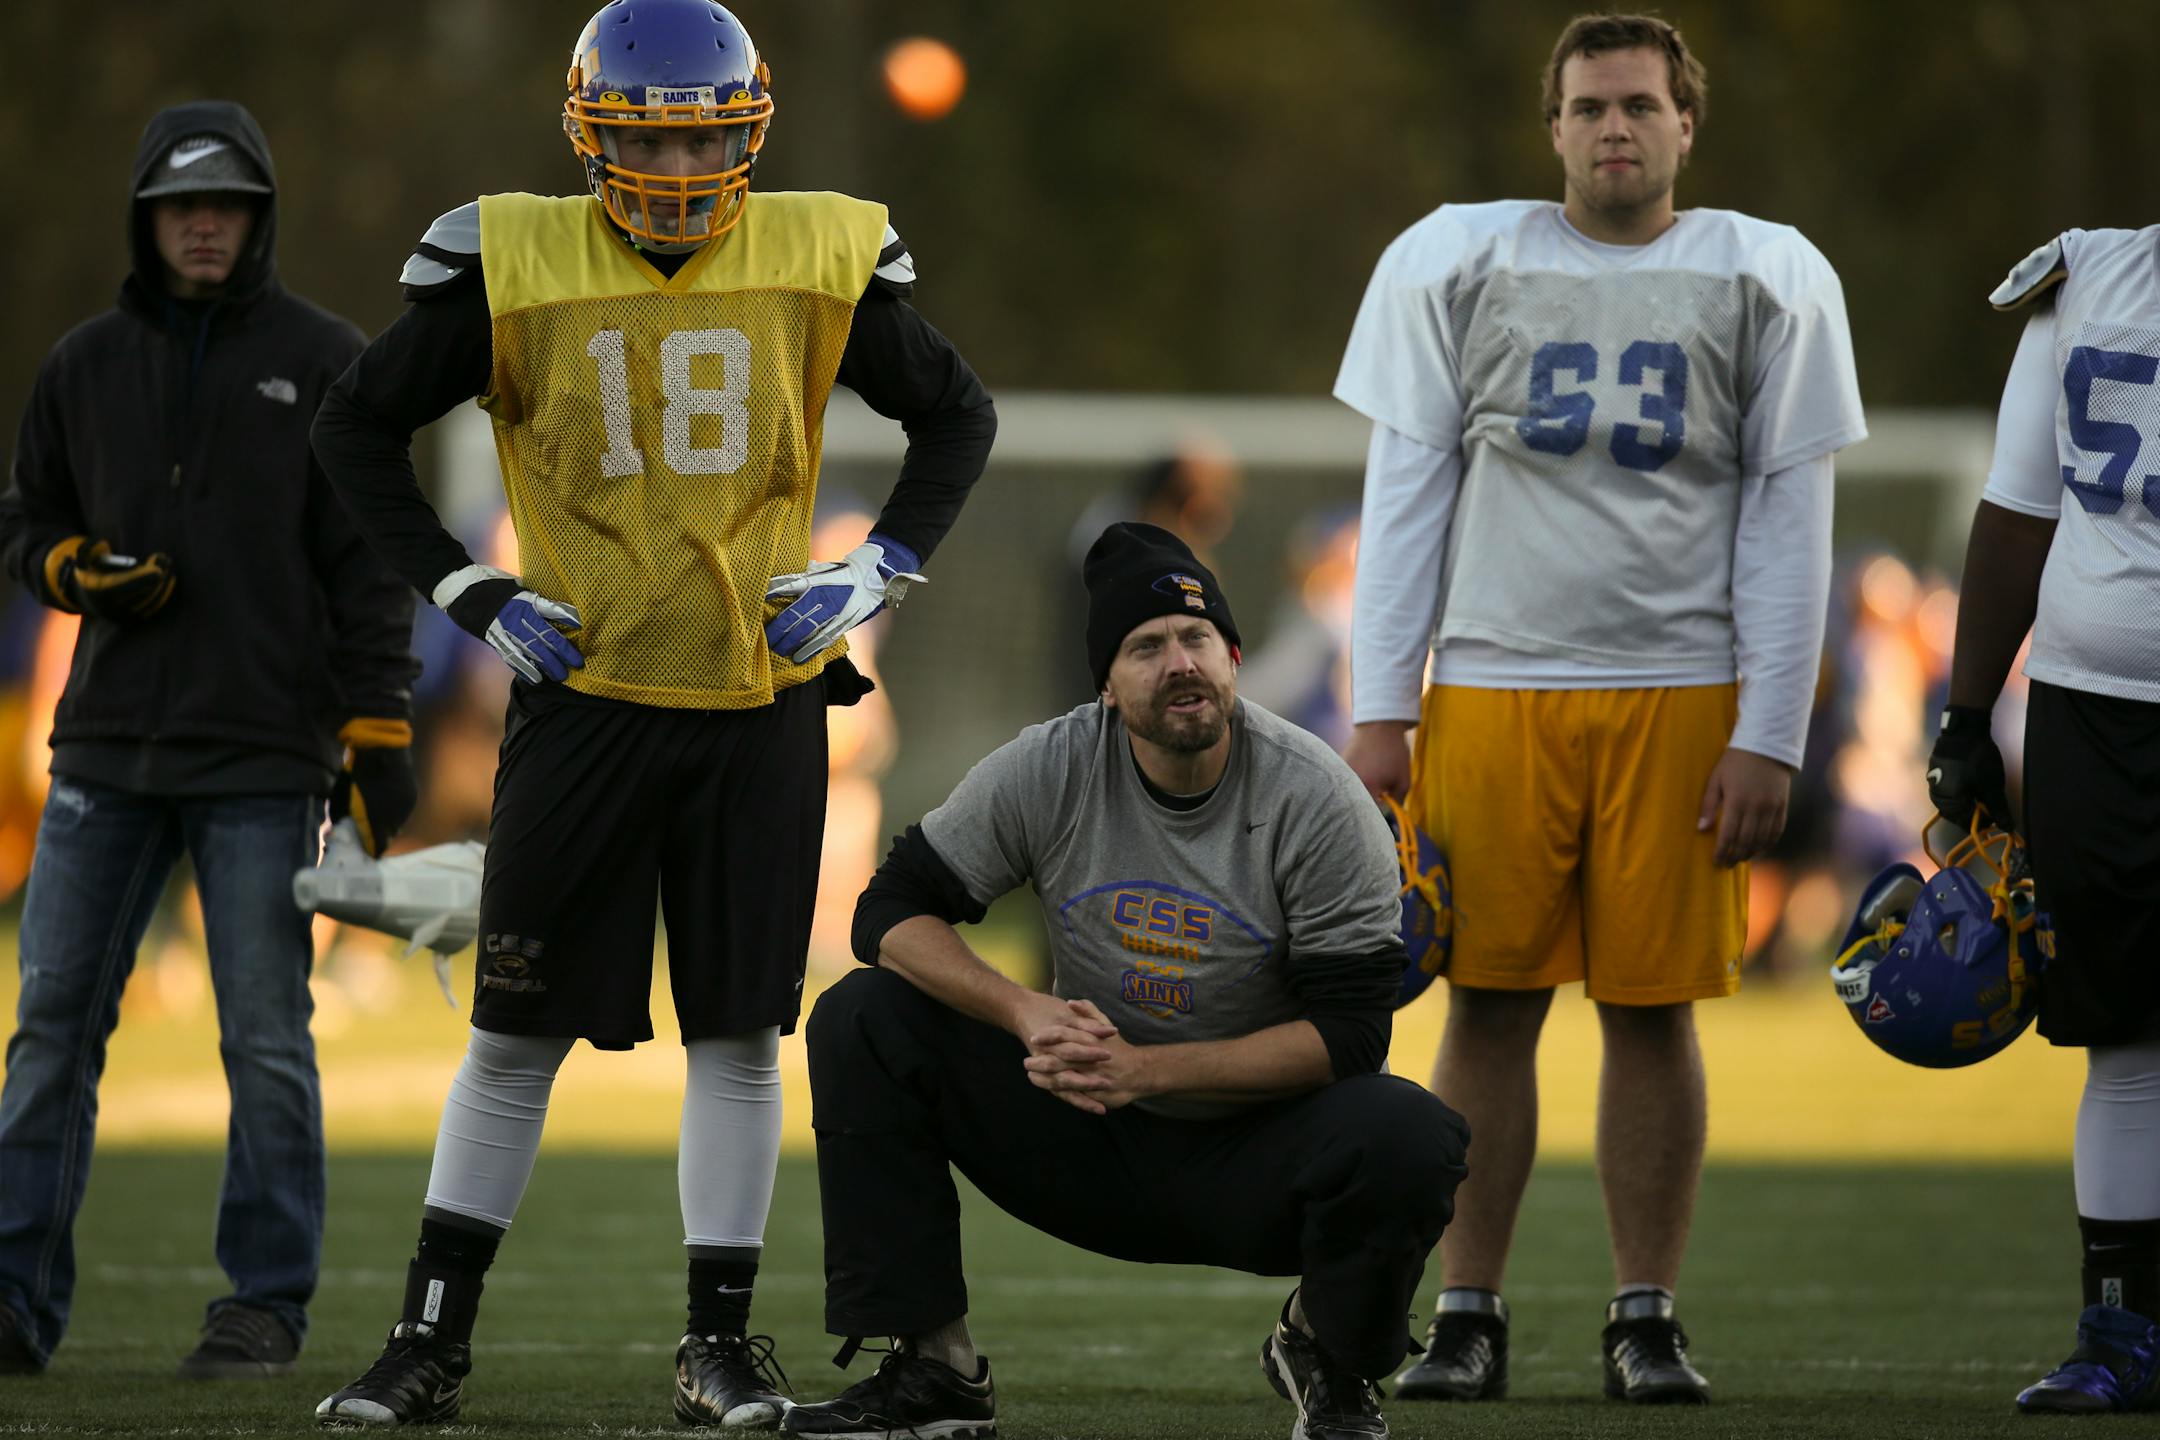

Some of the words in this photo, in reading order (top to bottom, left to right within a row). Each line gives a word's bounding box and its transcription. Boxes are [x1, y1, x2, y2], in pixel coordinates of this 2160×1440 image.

[662, 91, 699, 104] SAINTS
[586, 328, 752, 477] 18
[2061, 346, 2160, 519] 5
[1112, 890, 1213, 944] CSS
[1122, 971, 1193, 1013] SAINTS
